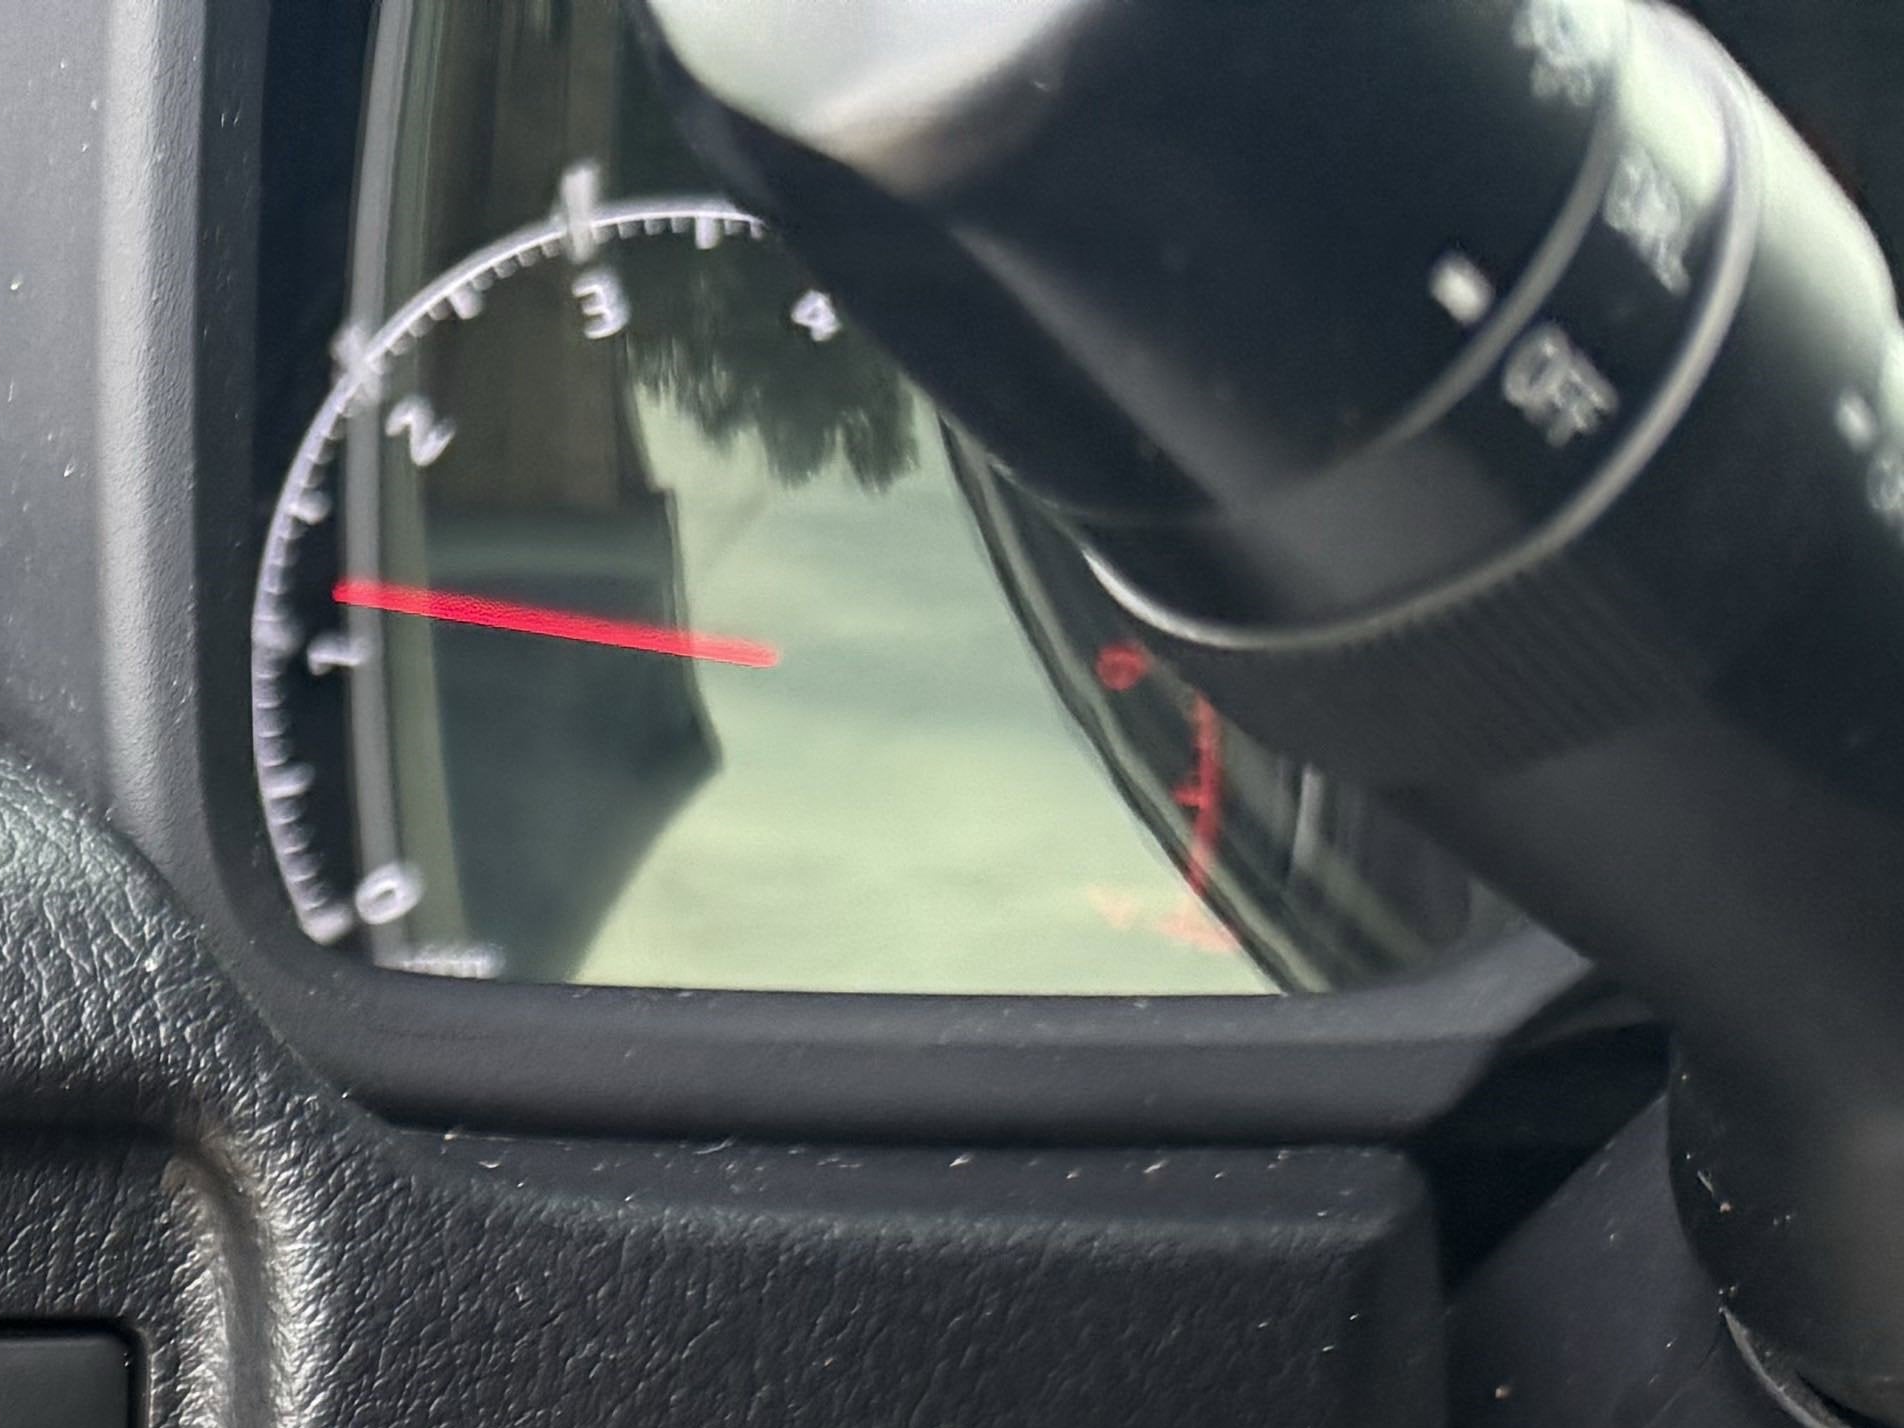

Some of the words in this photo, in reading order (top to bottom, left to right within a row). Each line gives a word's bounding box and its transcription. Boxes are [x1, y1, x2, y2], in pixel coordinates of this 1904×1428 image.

[571, 268, 630, 339] 3
[792, 289, 841, 341] 4
[385, 395, 456, 467] 2
[307, 632, 374, 676] 1
[355, 862, 424, 925] 0
